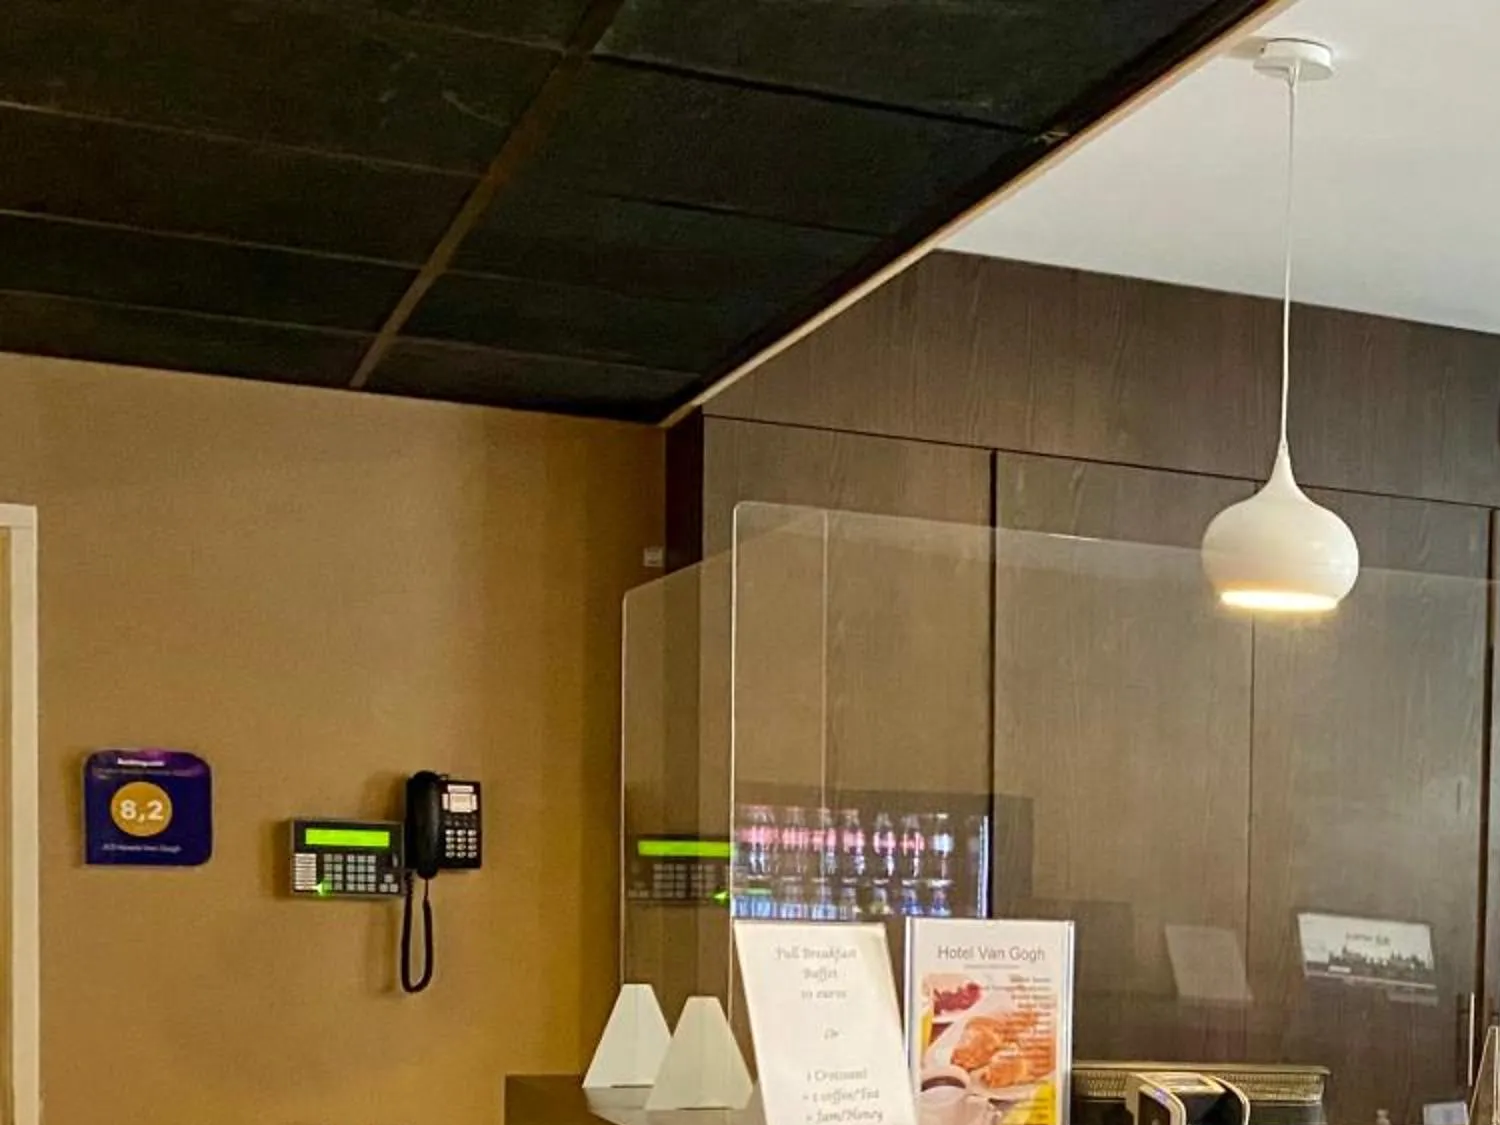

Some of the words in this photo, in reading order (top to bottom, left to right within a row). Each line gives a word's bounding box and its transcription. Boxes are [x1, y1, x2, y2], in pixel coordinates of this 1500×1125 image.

[119, 799, 165, 823] 8,2
[802, 945, 857, 963] Breakfast
[937, 945, 974, 959] Hotel
[976, 945, 1005, 960] Van
[1008, 945, 1046, 963] Gogh
